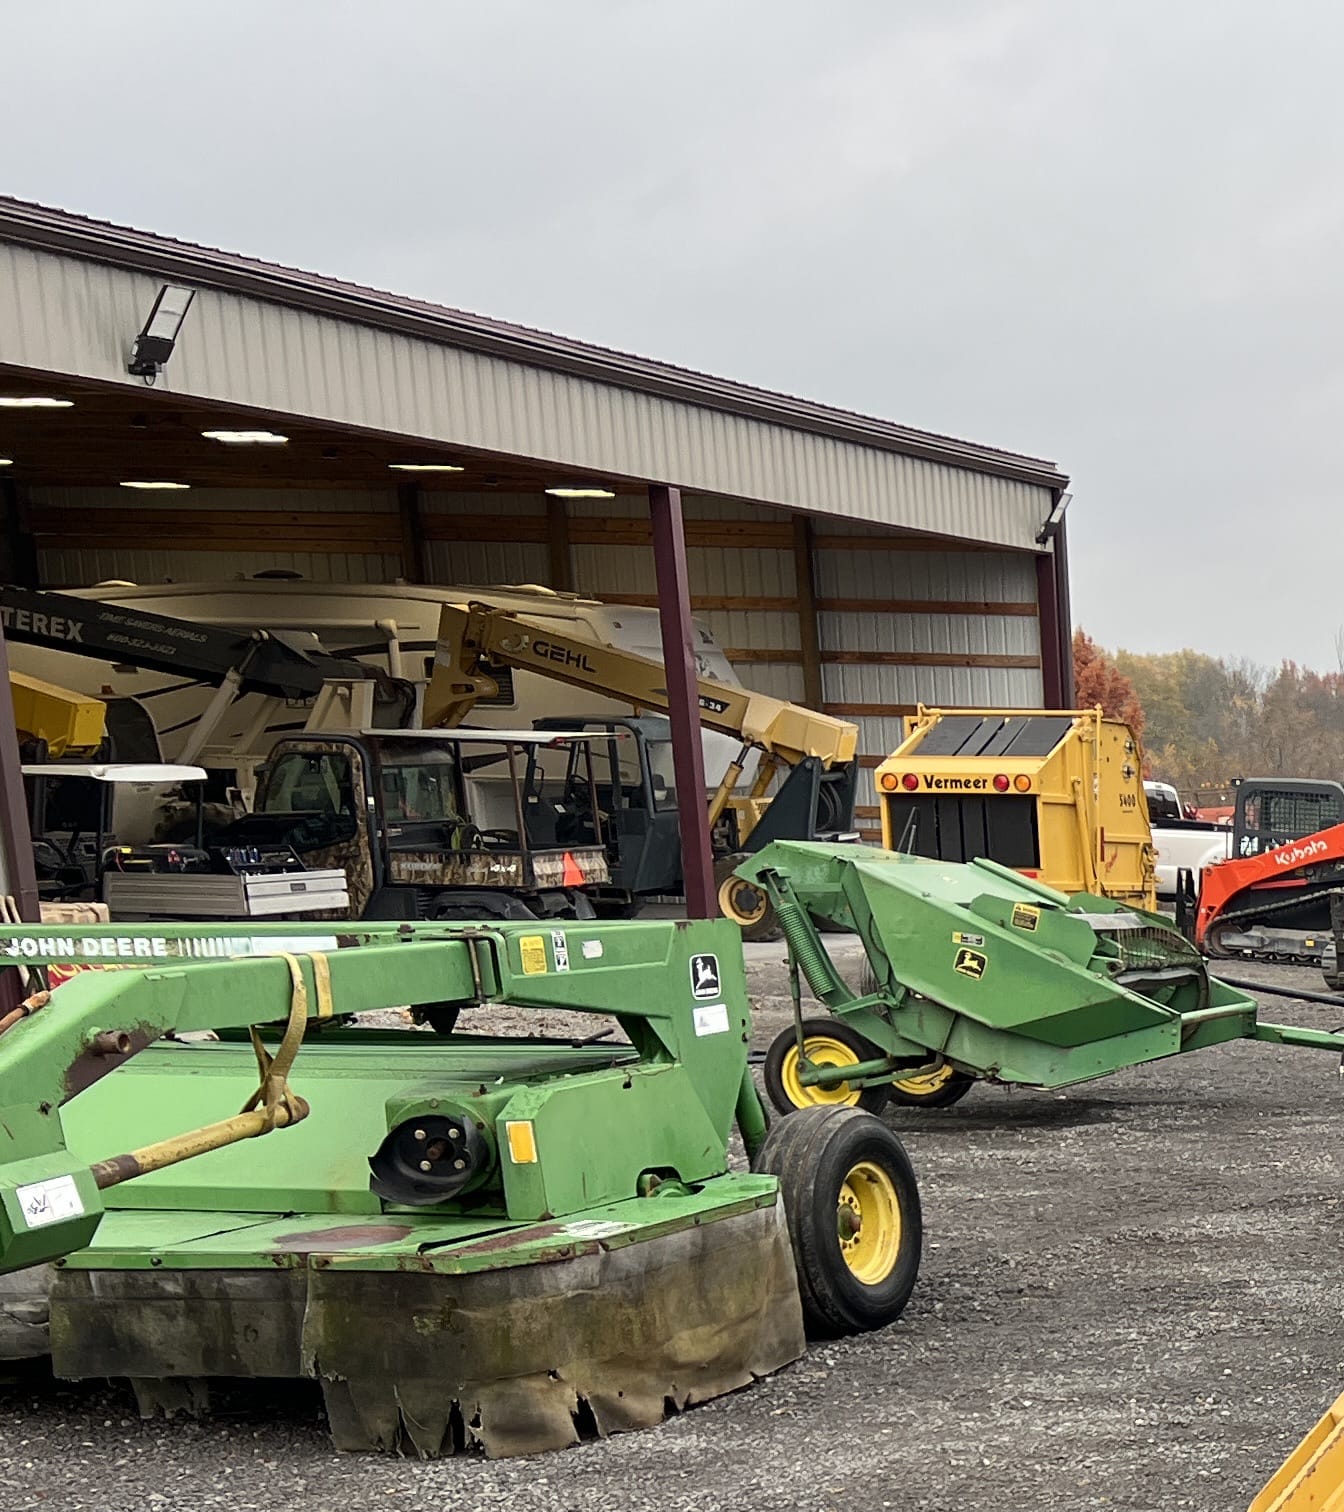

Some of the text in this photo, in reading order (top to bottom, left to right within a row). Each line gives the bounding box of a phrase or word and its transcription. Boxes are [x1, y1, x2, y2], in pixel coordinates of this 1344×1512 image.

[2, 606, 83, 643] TEREX
[532, 640, 597, 673] GEHL
[923, 775, 988, 790] Vermeer
[1274, 839, 1328, 865] Kubota
[5, 936, 168, 957] JOHN DEERE
